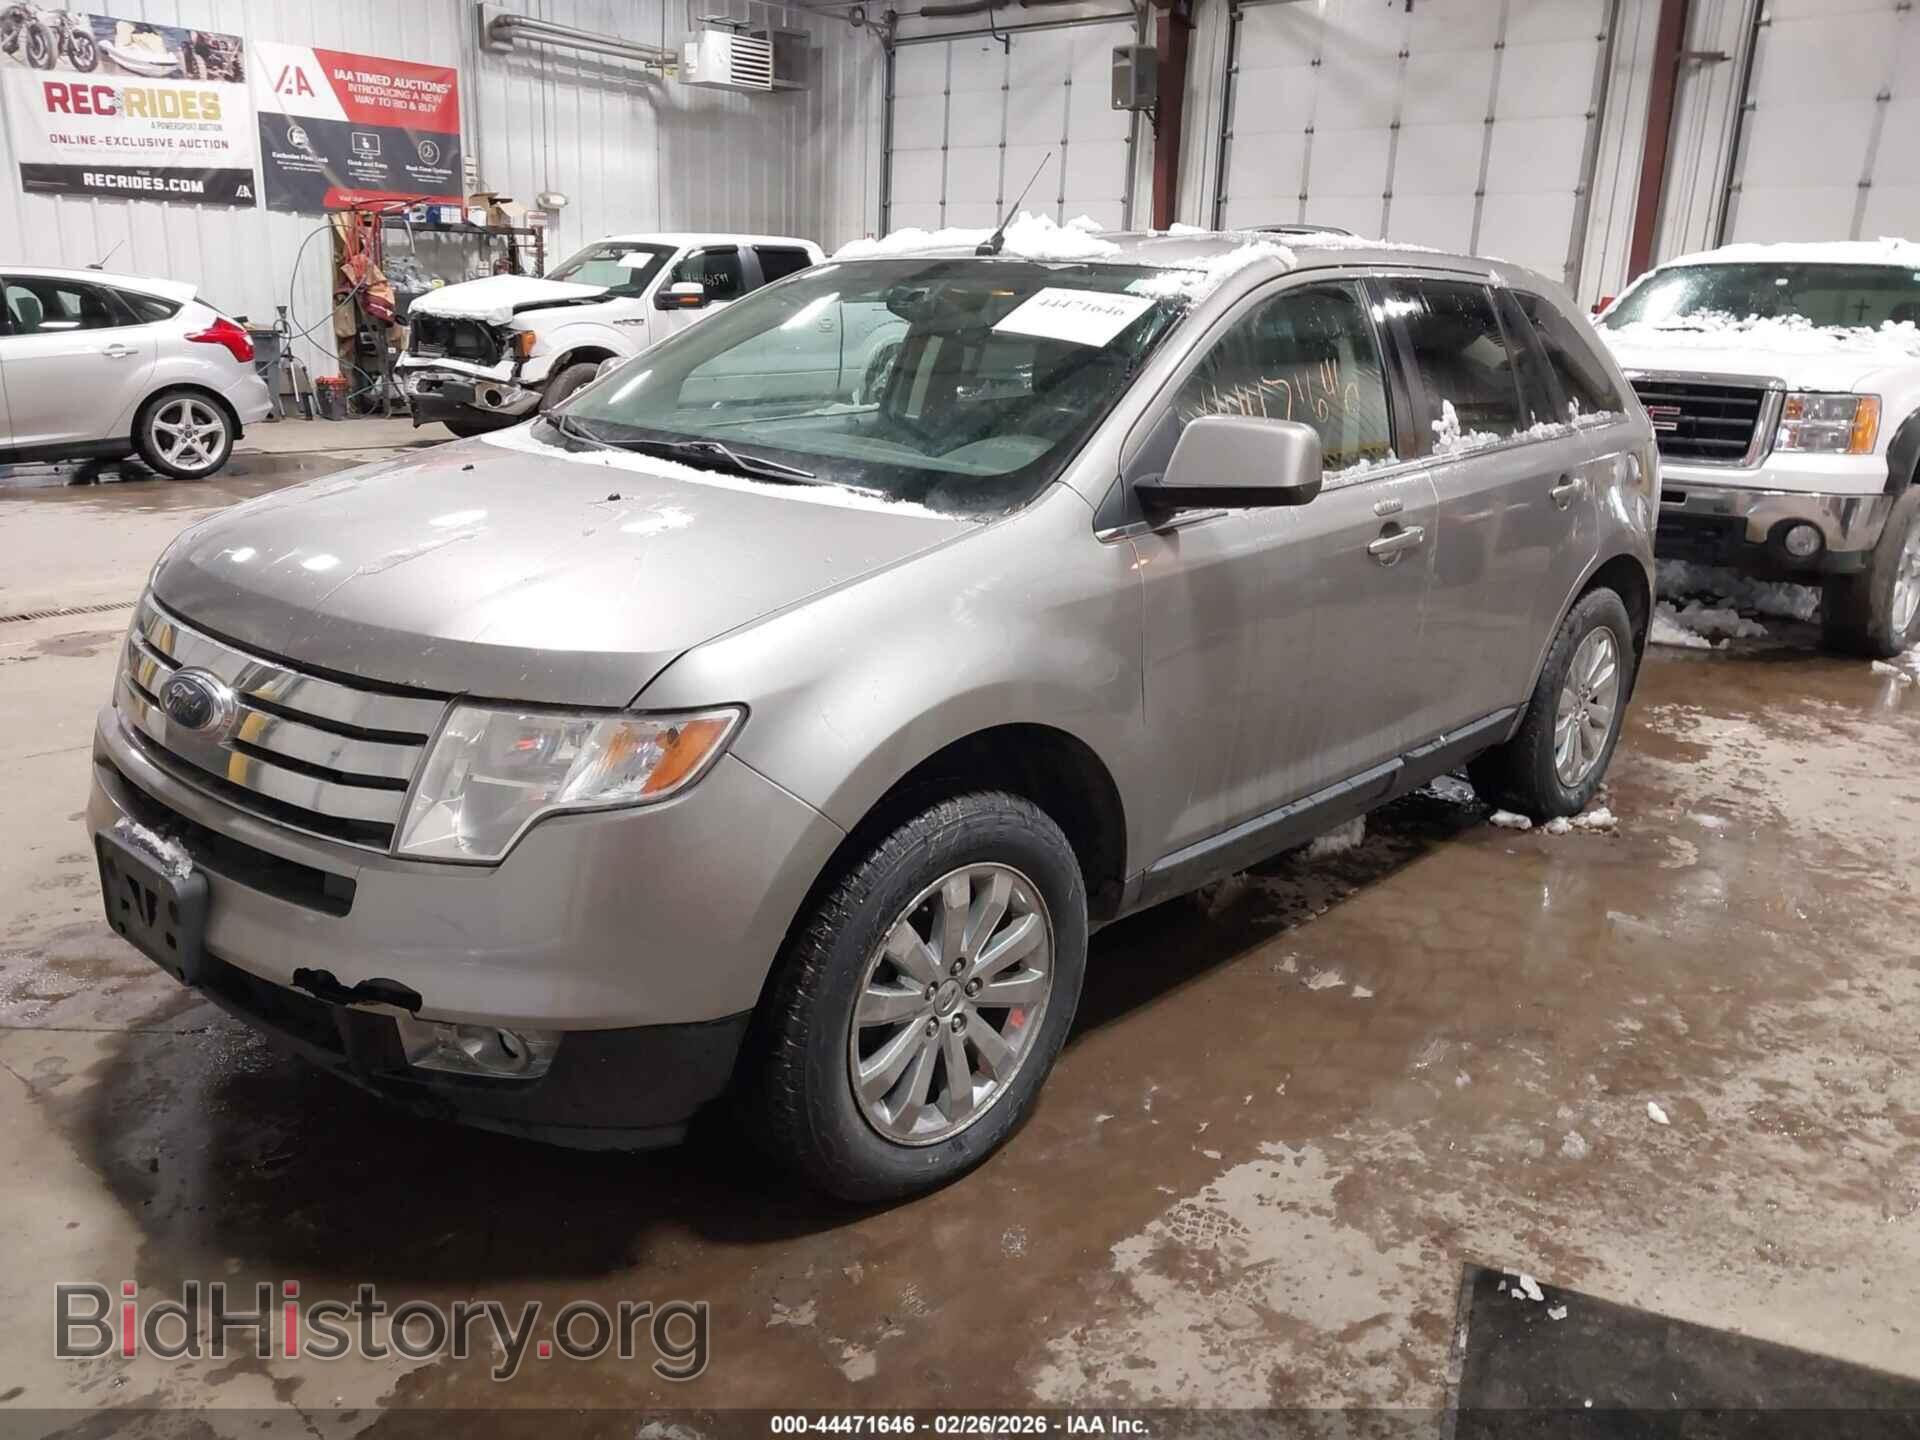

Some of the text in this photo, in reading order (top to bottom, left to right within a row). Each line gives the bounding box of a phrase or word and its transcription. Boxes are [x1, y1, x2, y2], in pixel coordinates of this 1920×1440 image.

[334, 69, 353, 81] IAA
[355, 72, 391, 86] TIMED
[43, 81, 222, 121] REC RIDES
[348, 83, 442, 104] INTRODUCING A NEW
[354, 94, 375, 105] WAY
[380, 97, 391, 107] TO
[409, 101, 417, 111] &
[418, 102, 438, 113] BUY
[50, 133, 229, 150] ONLINE-EXCLUSIVE AUCTION
[83, 172, 204, 194] RECRIDES.COM
